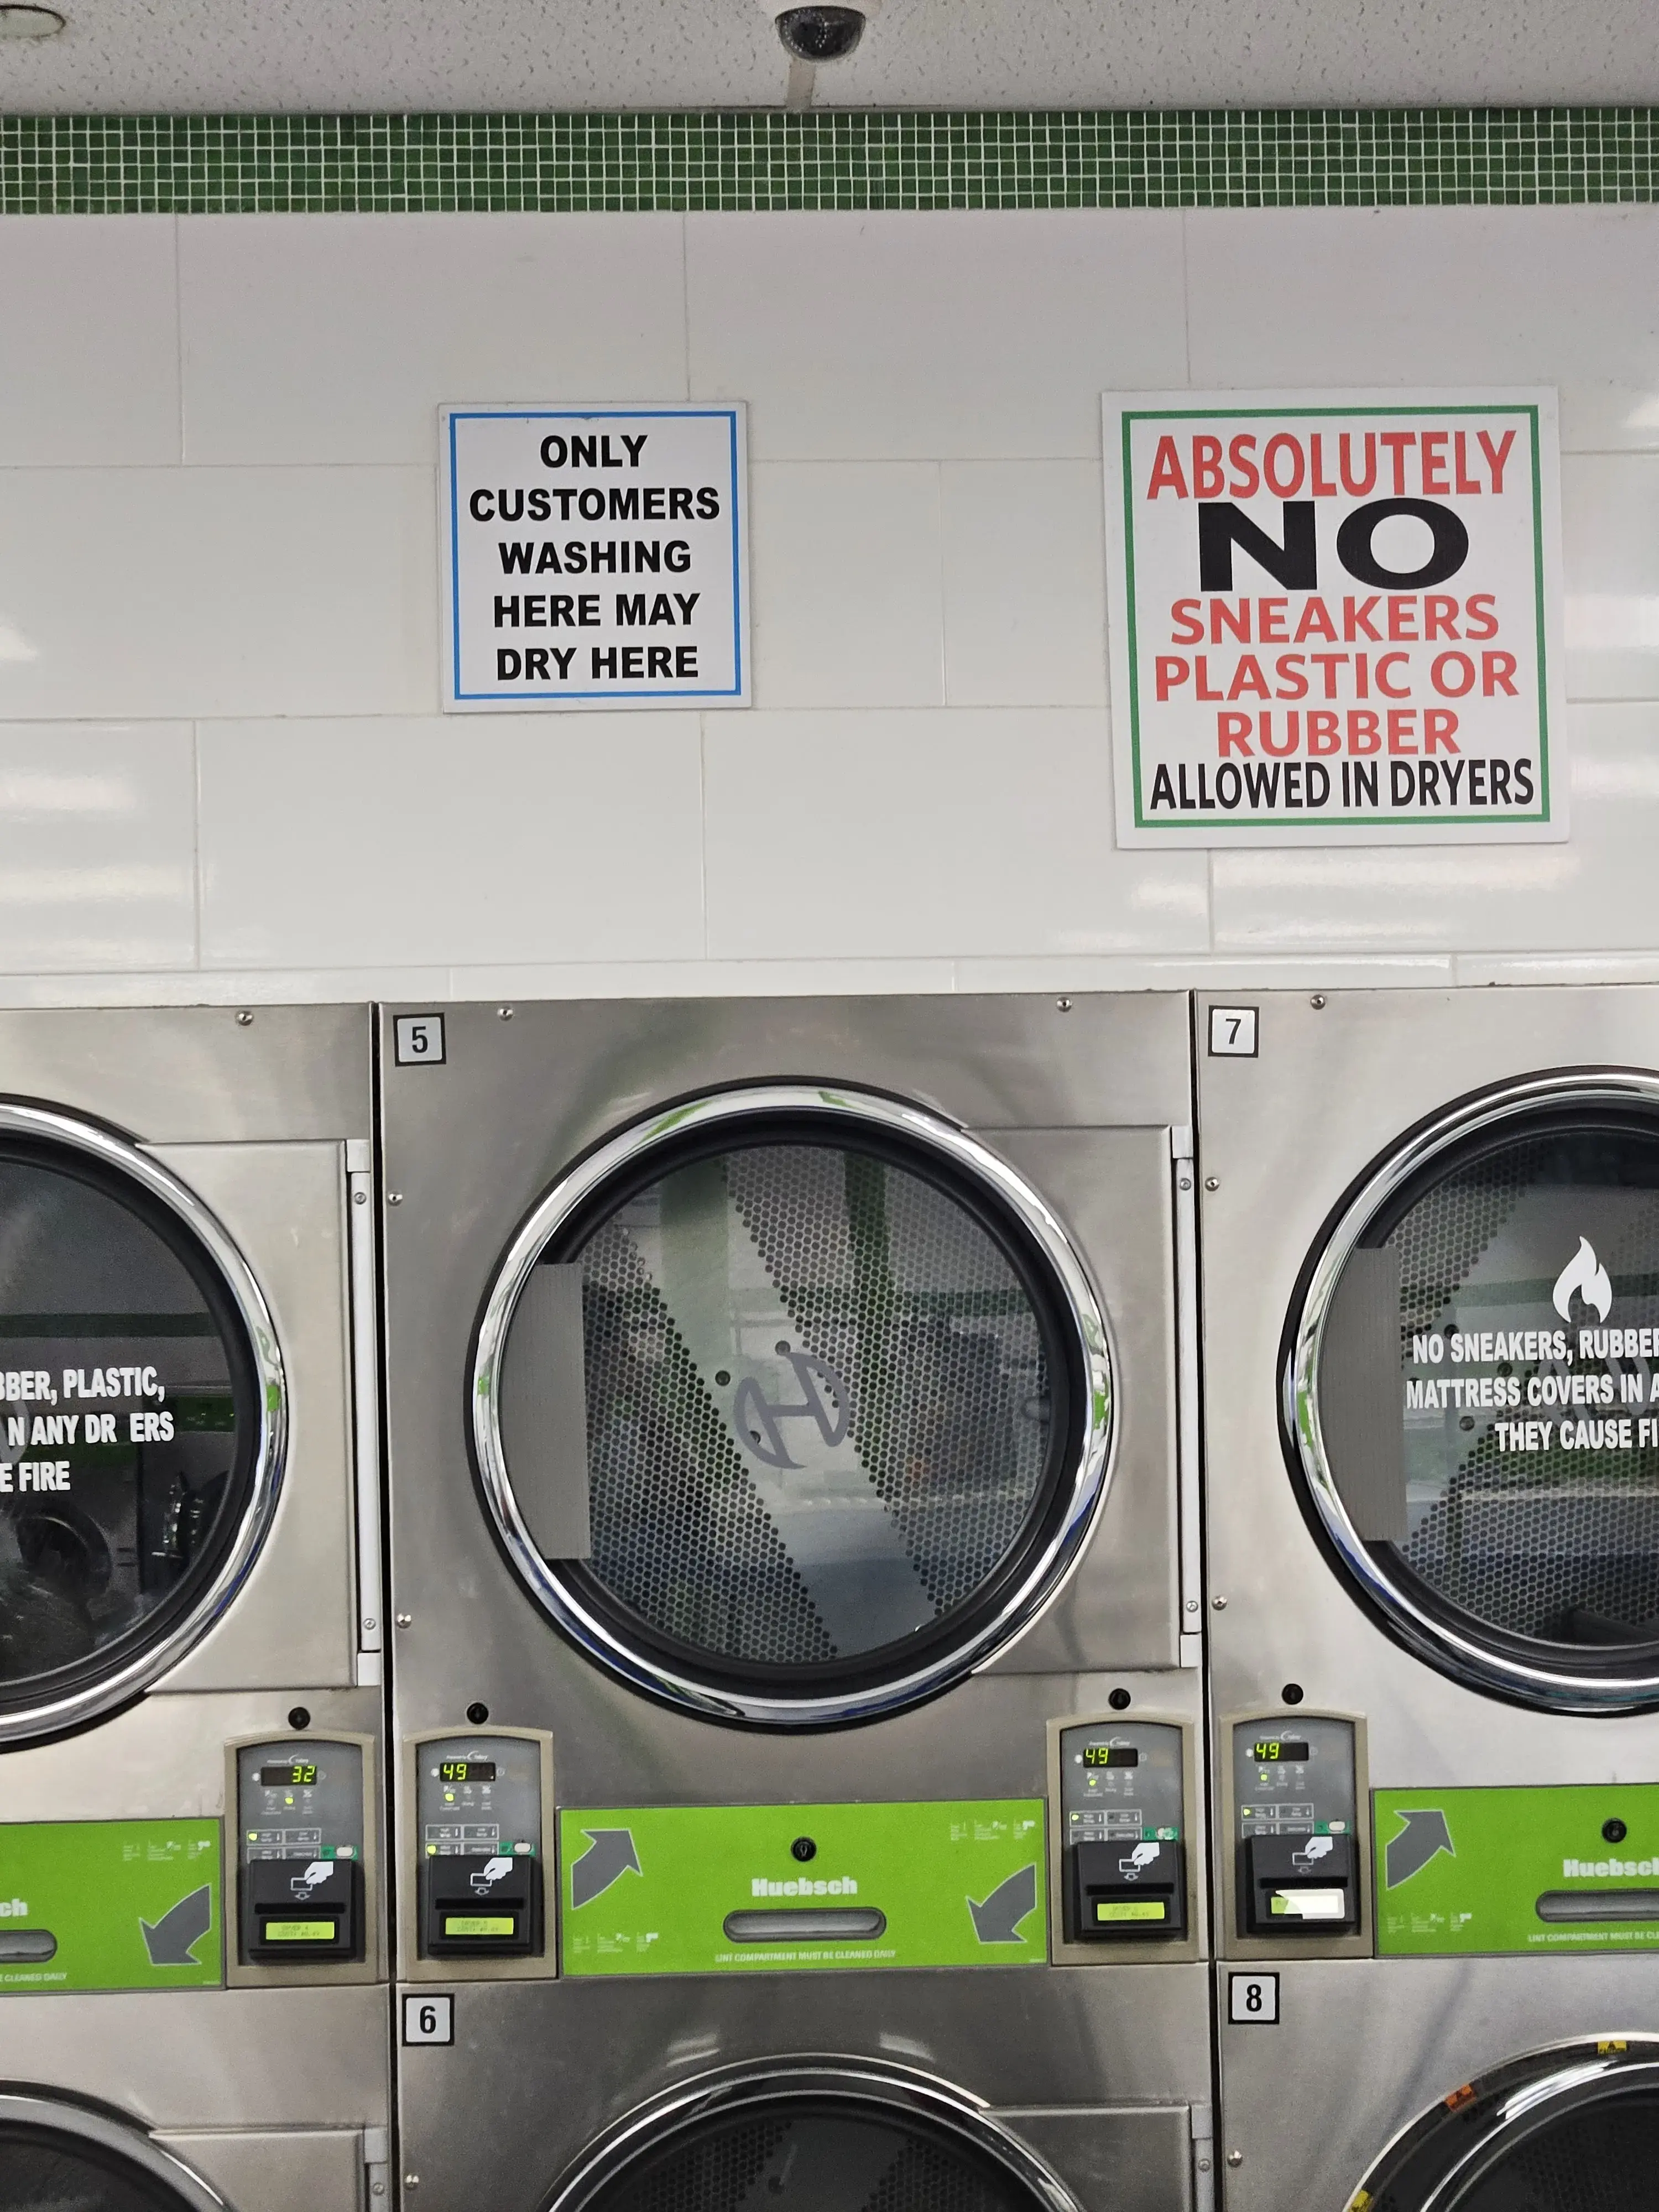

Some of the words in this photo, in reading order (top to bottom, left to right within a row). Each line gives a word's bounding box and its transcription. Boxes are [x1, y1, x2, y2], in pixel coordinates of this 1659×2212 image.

[540, 435, 648, 468] ONLY
[1147, 431, 1516, 499] ABSOLUTELY
[469, 487, 719, 521] CUSTOMERS
[499, 540, 691, 573] WASHING
[1198, 498, 1469, 592] NO
[494, 594, 601, 627] HERE
[616, 593, 701, 625] MAY
[1171, 594, 1499, 645] SNEAKERS
[497, 648, 577, 680] DRY
[592, 646, 698, 679] HERE
[1155, 652, 1411, 701] PLASTIC
[1431, 651, 1520, 697] OR
[1217, 709, 1460, 757] RUBBER
[1150, 762, 1330, 810] ALLOWED
[1342, 761, 1379, 807] IN
[1391, 758, 1533, 806] DRYERS
[412, 1026, 428, 1053] 5
[1225, 1018, 1241, 1045] 7
[1413, 1334, 1444, 1364] NO
[1451, 1330, 1573, 1366] SNEAKERS,
[63, 1366, 165, 1402] PLASTIC,
[1406, 1376, 1521, 1409] MATTRESS
[1527, 1374, 1614, 1406] COVERS
[1620, 1374, 1643, 1403] IN
[30, 1415, 79, 1446] ANY
[1495, 1421, 1553, 1452] THEY
[1560, 1419, 1632, 1450] CAUSE
[19, 1461, 71, 1492] FIRE
[1086, 1747, 1108, 1764] 49
[1256, 1743, 1279, 1759] 49
[293, 1765, 315, 1782] 32
[444, 1764, 467, 1780] 49
[752, 1876, 858, 1897] Huebsch
[1246, 1984, 1262, 2012] 8
[419, 2005, 436, 2034] 6
